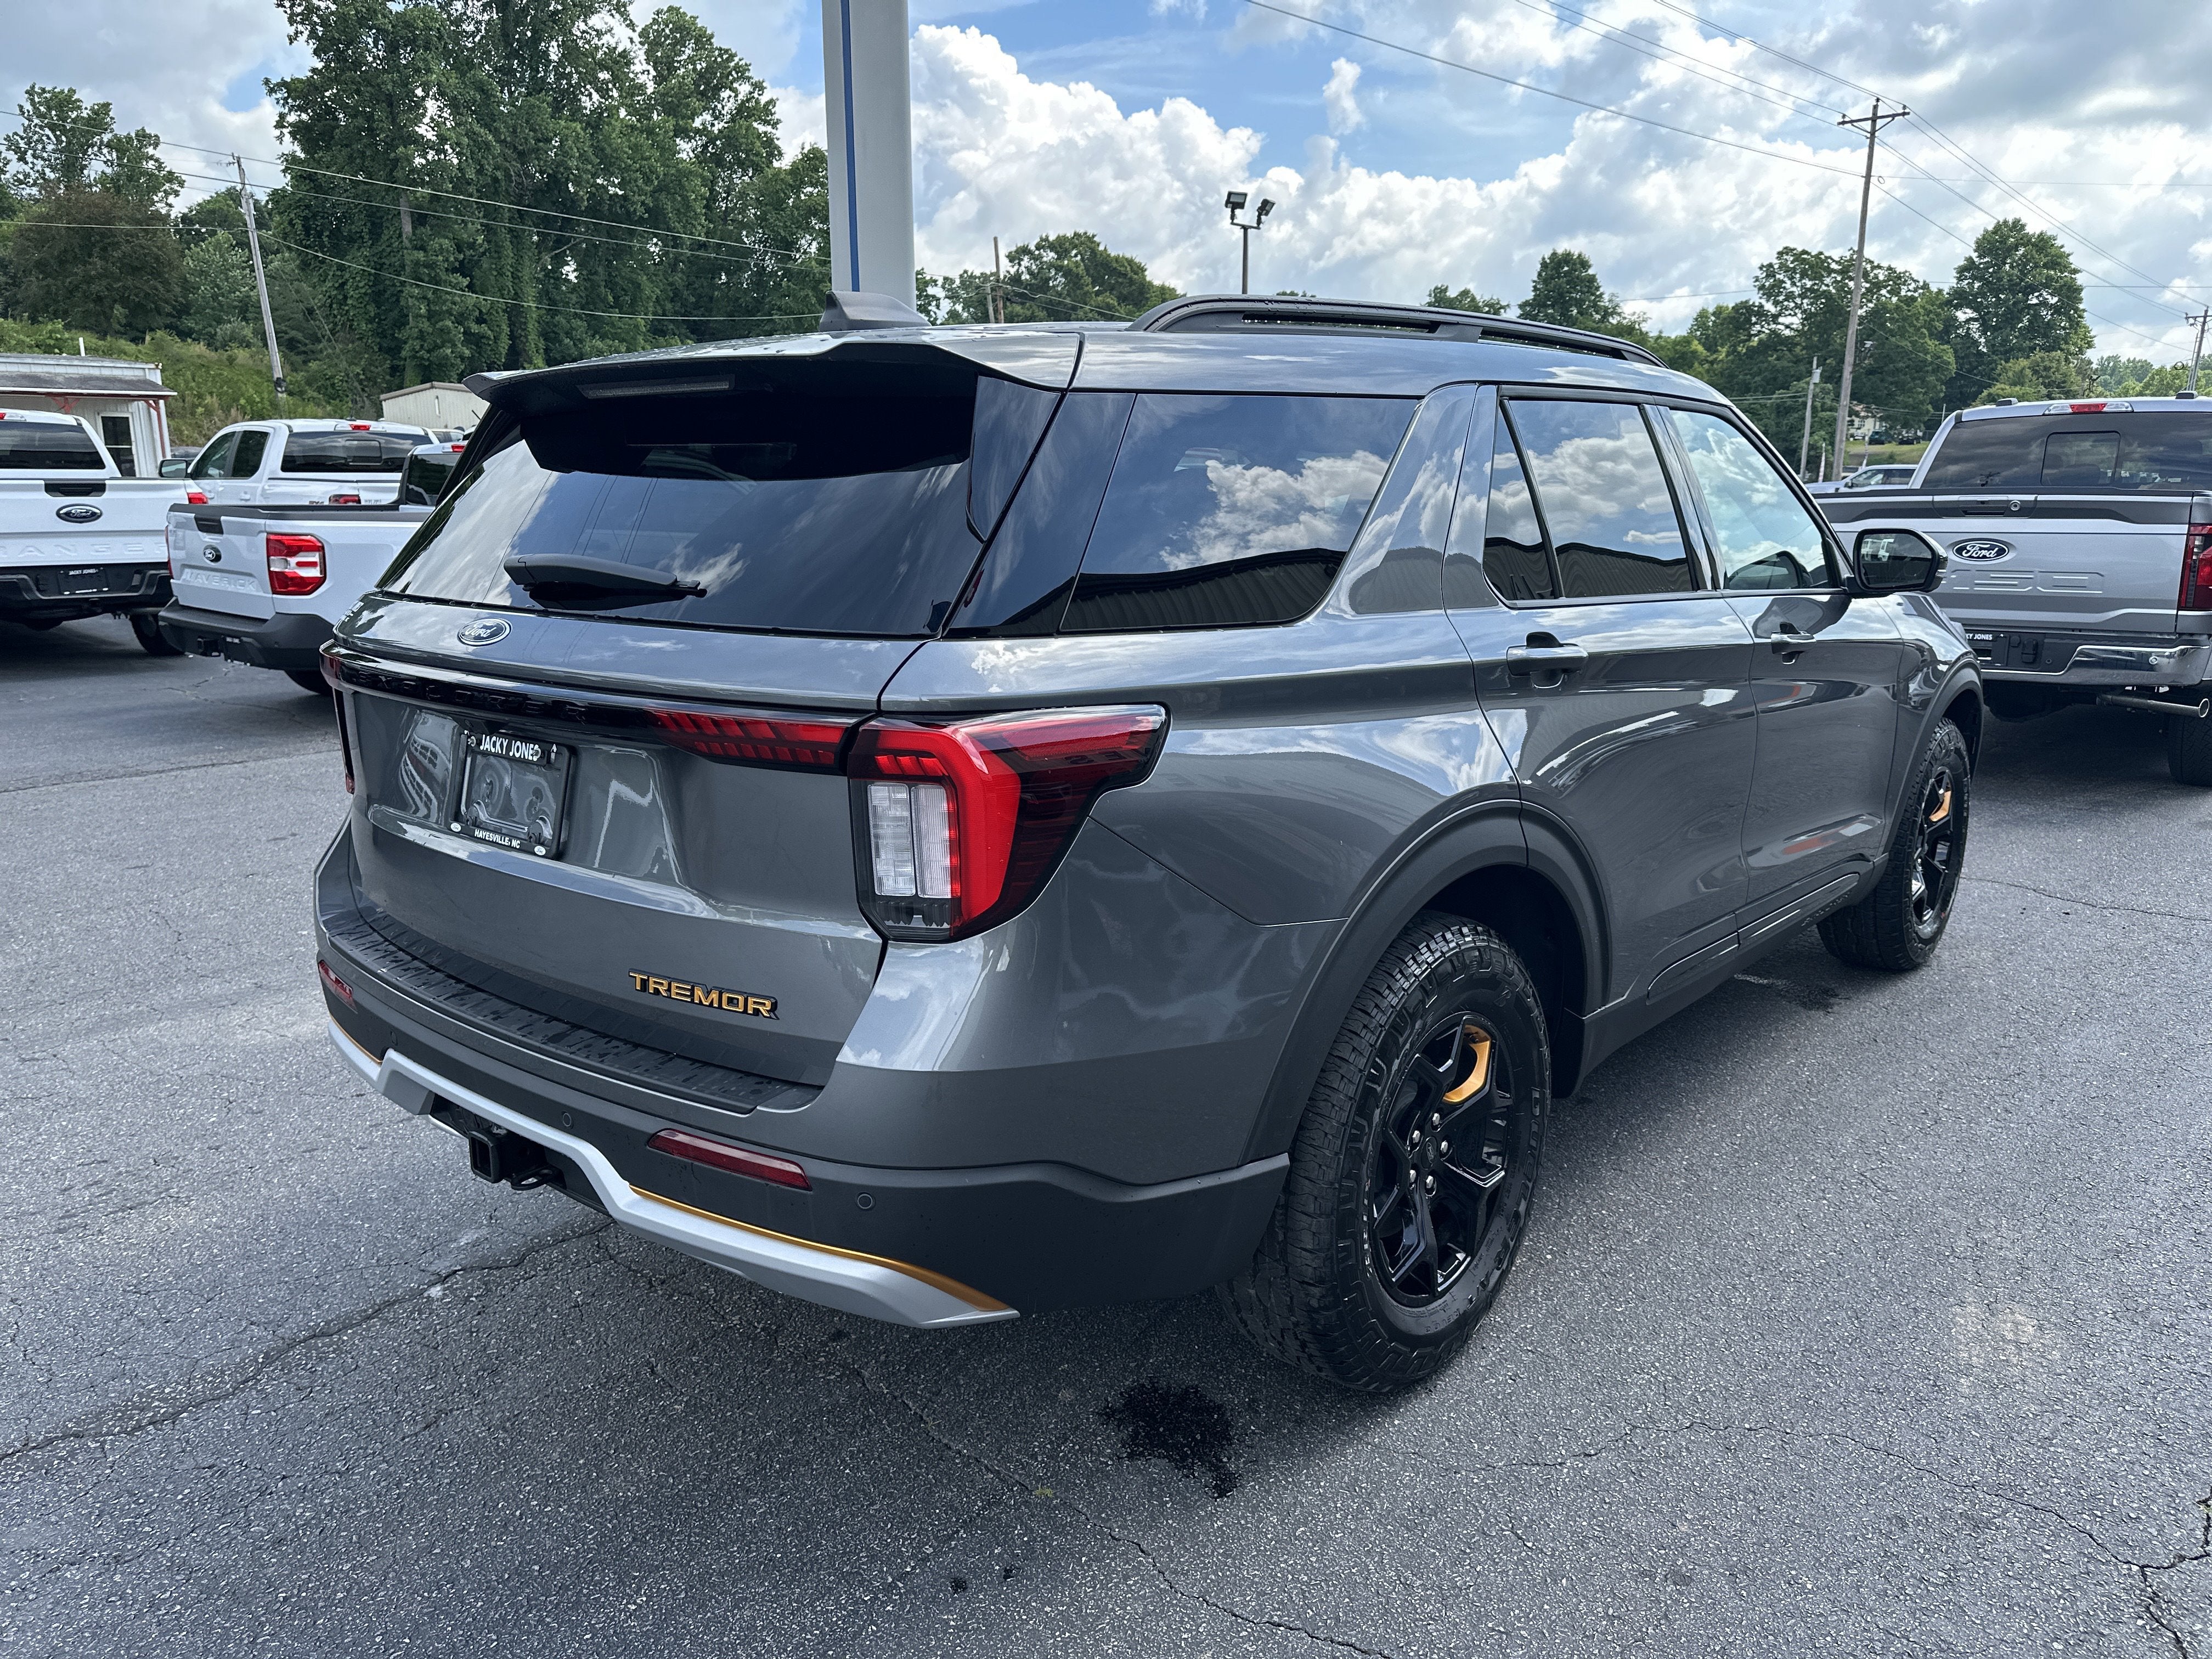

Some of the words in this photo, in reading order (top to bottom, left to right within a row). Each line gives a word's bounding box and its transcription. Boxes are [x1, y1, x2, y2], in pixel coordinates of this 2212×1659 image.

[1962, 543, 1999, 558] Ford
[479, 734, 509, 755] JACKY
[509, 740, 539, 761] JONES
[474, 828, 511, 846] HAYESVILLE,
[511, 839, 521, 849] NC
[628, 968, 780, 1020] TREMOR
